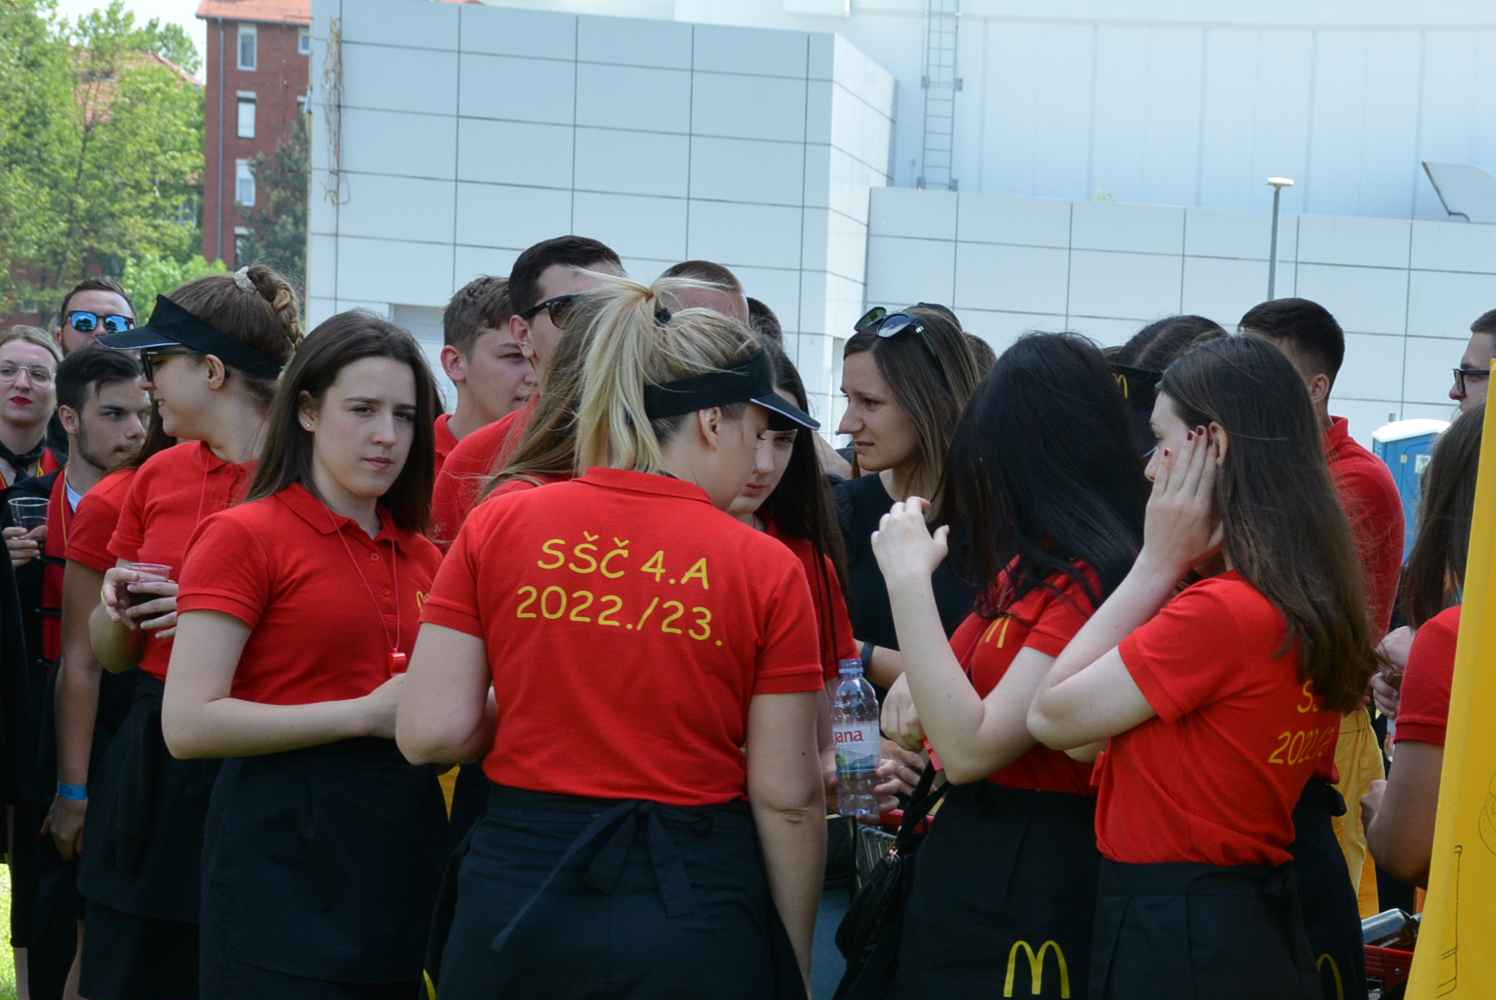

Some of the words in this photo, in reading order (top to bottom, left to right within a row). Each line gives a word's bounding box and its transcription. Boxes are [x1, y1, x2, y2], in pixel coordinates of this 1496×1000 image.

[537, 531, 629, 579] SŠČ
[640, 550, 709, 590] 4.A
[516, 585, 723, 646] 2022./23.
[832, 730, 864, 745] ana
